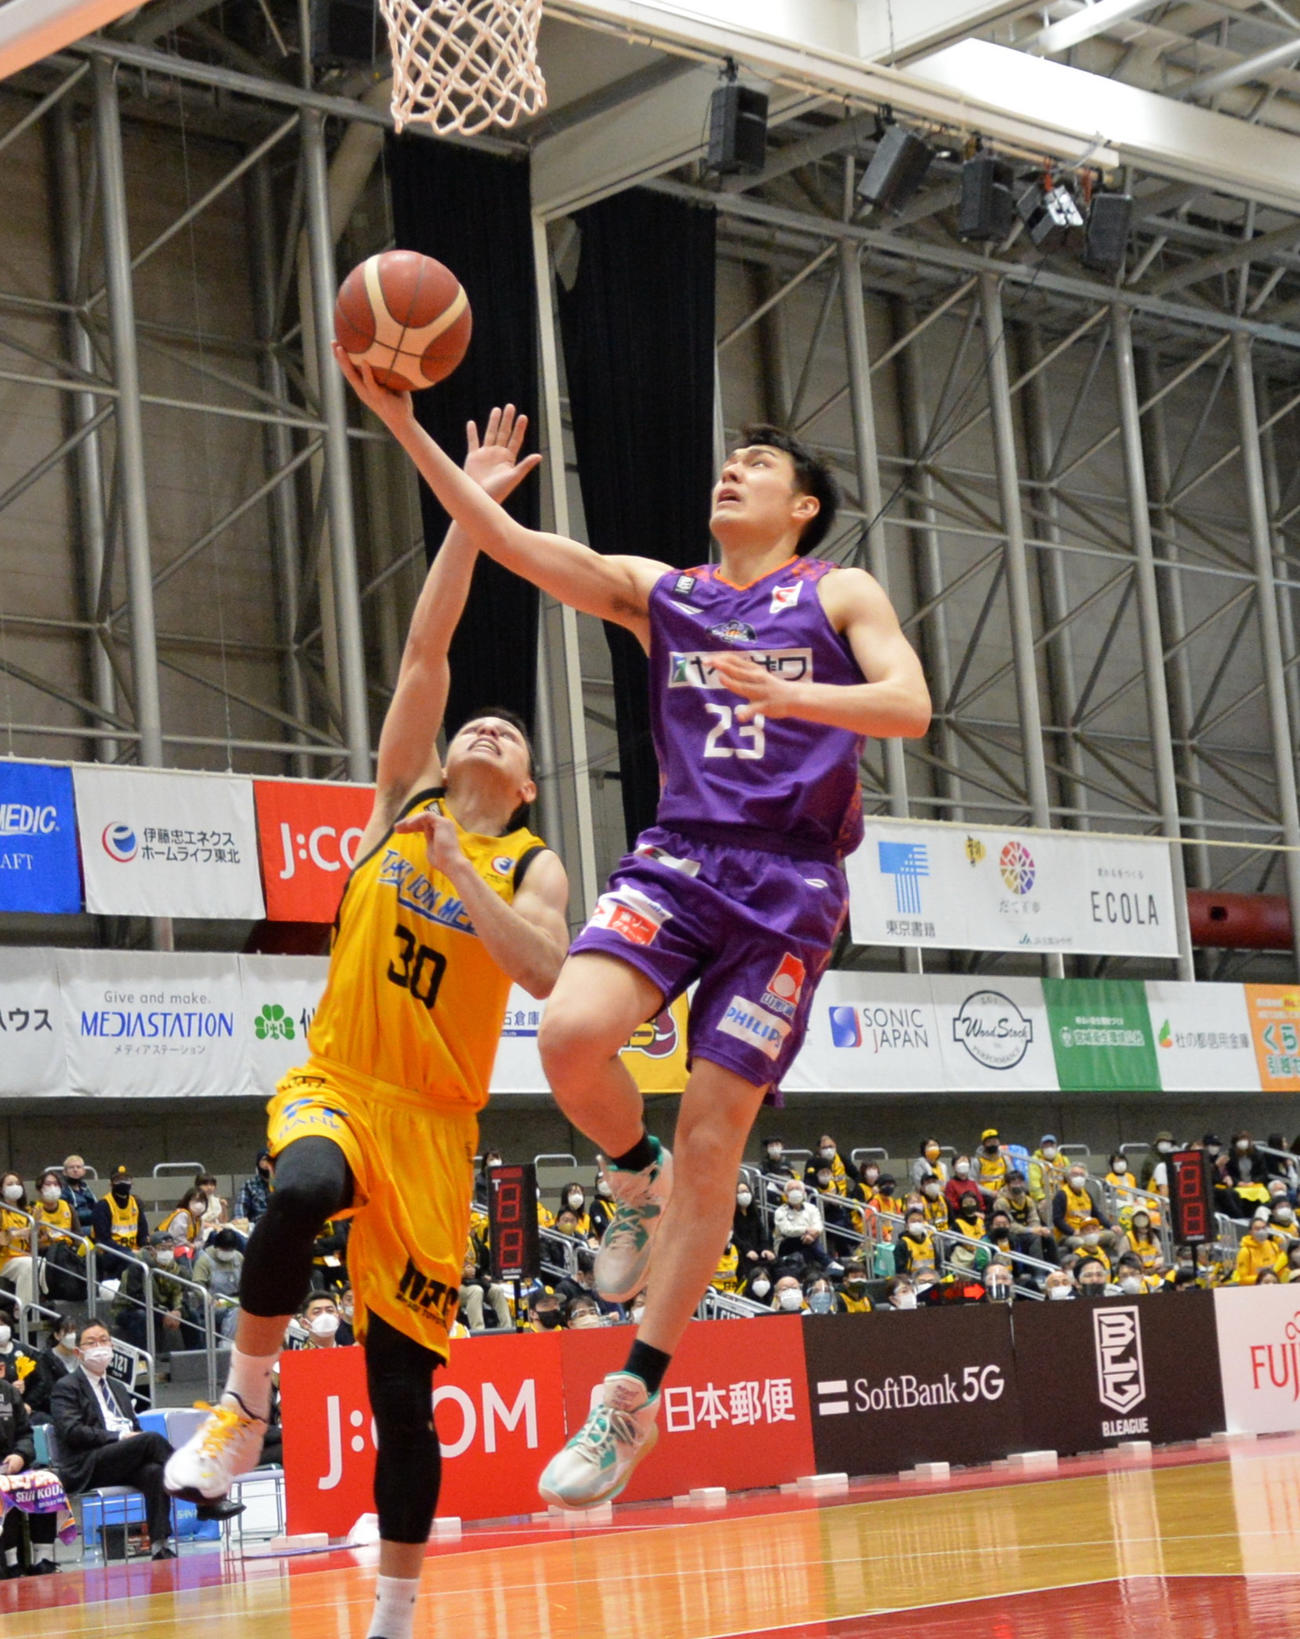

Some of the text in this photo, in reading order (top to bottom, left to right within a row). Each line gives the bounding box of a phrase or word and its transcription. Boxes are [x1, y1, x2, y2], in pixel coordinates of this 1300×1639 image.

[704, 703, 765, 760] 23
[144, 828, 235, 846] 伊藤忠エネクス
[142, 845, 240, 864] ホームライフ東北
[1091, 891, 1159, 925] ECOLA
[388, 923, 447, 1010] 30
[104, 991, 134, 1004] Give
[140, 992, 164, 1004] and
[81, 1011, 233, 1038] MEDIASTATION
[863, 1008, 924, 1029] SONIC
[114, 1045, 206, 1056] メディアステーション
[873, 1028, 929, 1053] JAPAN
[854, 1364, 1005, 1412] SoftBank 5G
[664, 1378, 795, 1432] 日本郵便
[317, 1378, 538, 1490] J:OM
[1102, 1417, 1149, 1437] B.LEAGUE
